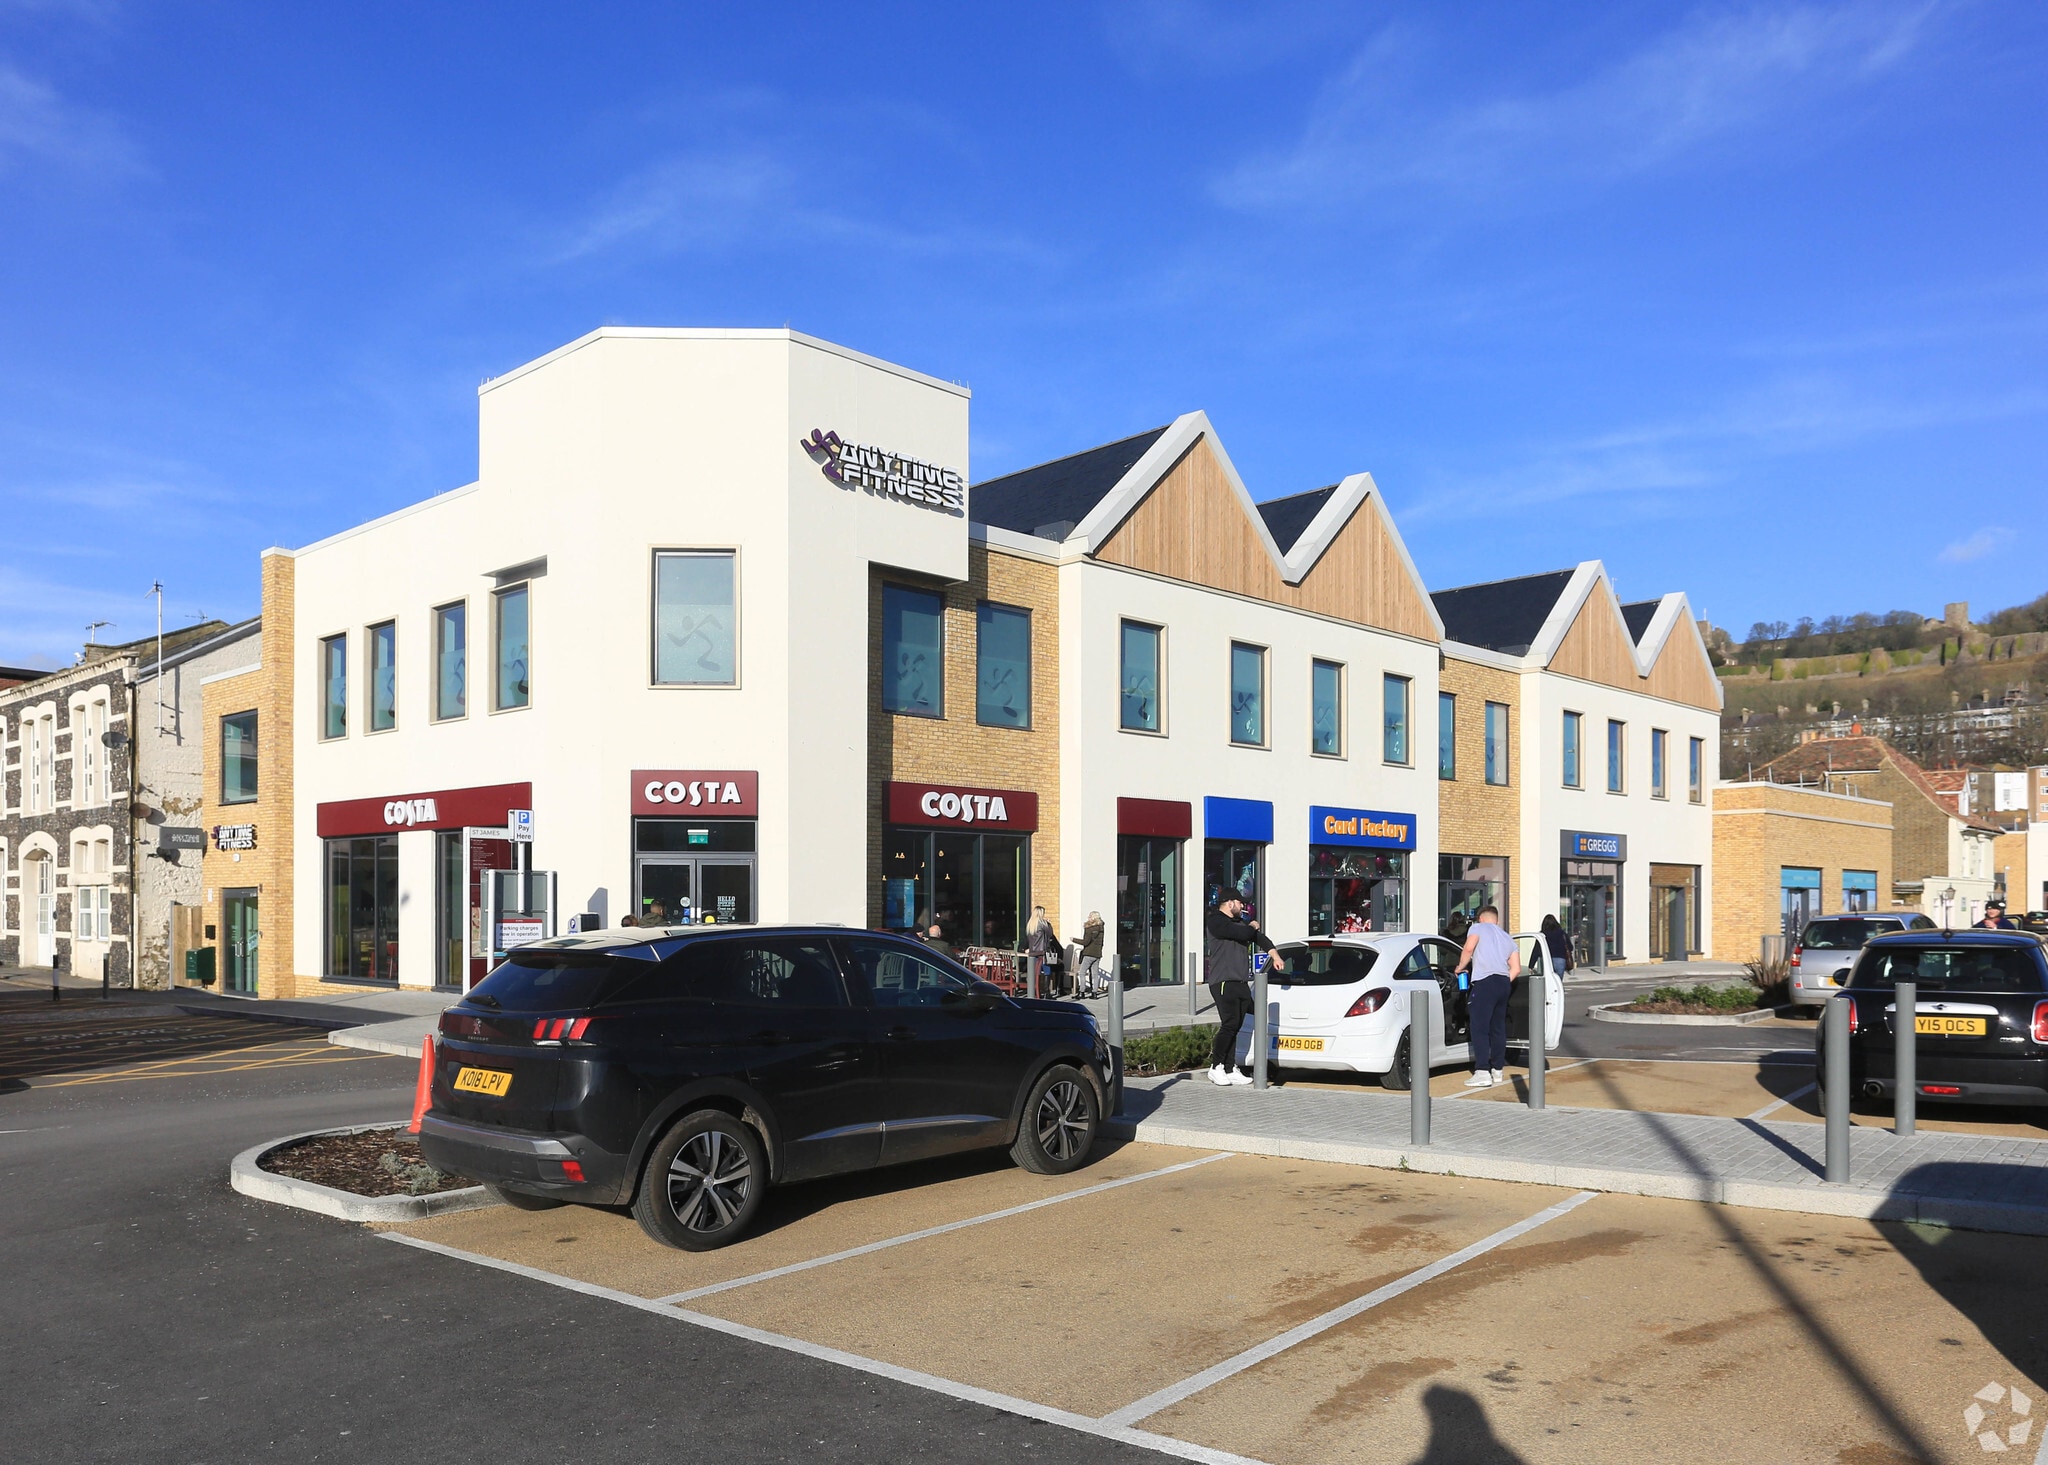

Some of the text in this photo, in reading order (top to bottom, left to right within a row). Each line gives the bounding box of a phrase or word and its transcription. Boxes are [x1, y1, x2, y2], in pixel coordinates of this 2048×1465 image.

[839, 438, 960, 490] ANYTIME
[842, 462, 961, 509] FITNESS
[644, 780, 743, 807] COSTA
[384, 798, 438, 826] COSTA
[920, 790, 1008, 823] COSTA
[218, 824, 254, 839] ANYTIME
[516, 832, 532, 840] Here
[518, 824, 530, 833] Pay
[1324, 815, 1408, 843] Card Factory
[218, 838, 254, 850] FITNESS
[1587, 838, 1617, 853] GREGGS
[1945, 1019, 1976, 1033] OCS
[1303, 1039, 1323, 1050] OGB
[481, 1072, 504, 1091] LPV
